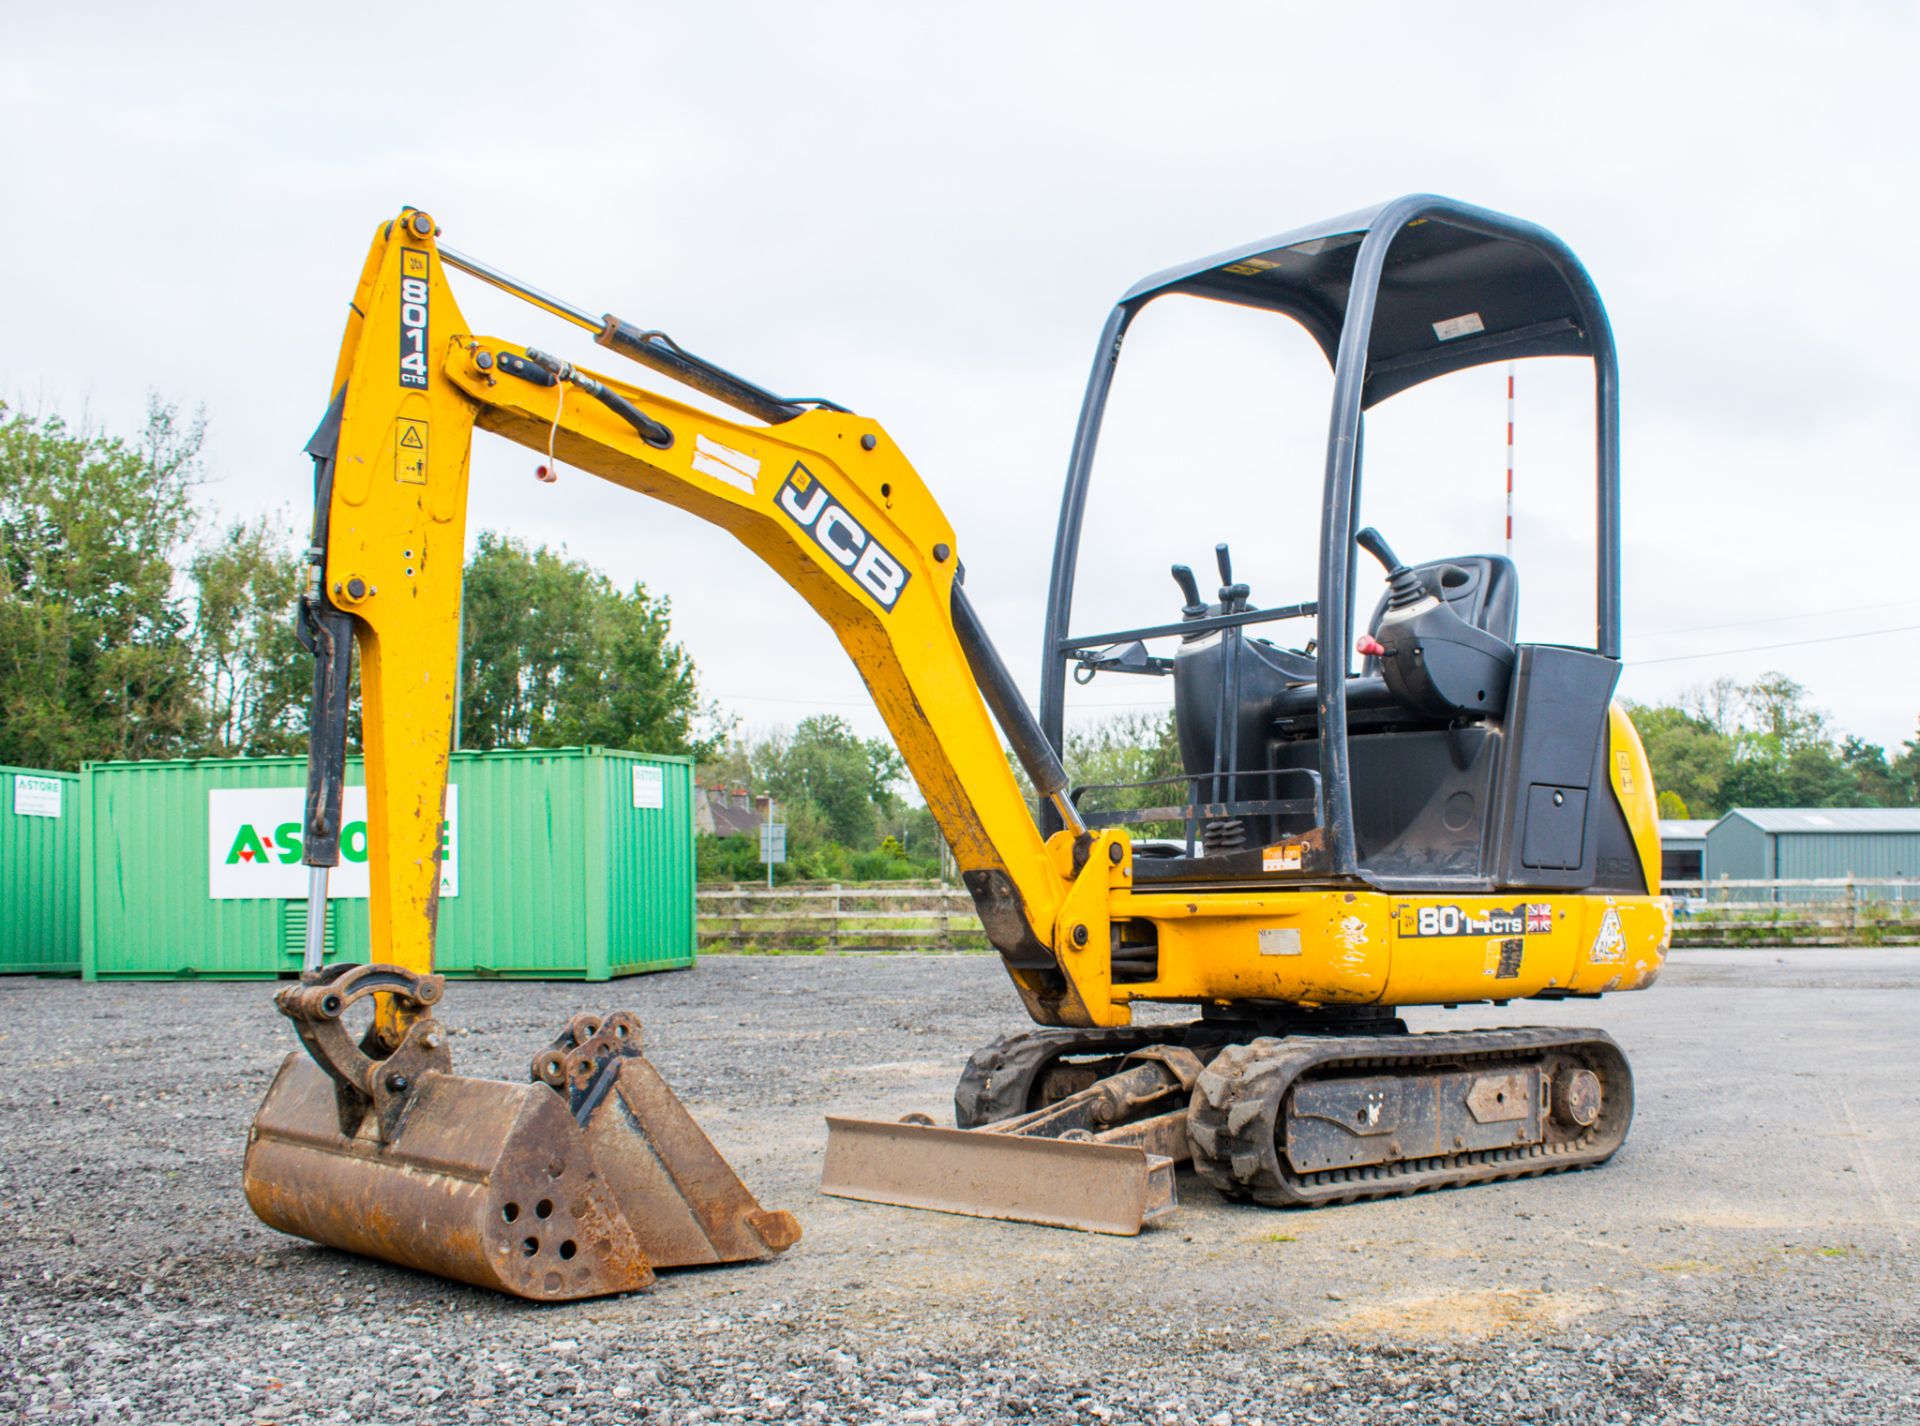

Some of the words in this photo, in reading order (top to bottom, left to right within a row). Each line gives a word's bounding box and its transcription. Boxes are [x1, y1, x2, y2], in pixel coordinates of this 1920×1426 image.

[402, 278, 428, 376] 8014
[401, 374, 426, 385] CTS
[781, 484, 905, 605] JCB
[1492, 917, 1523, 933] CTS
